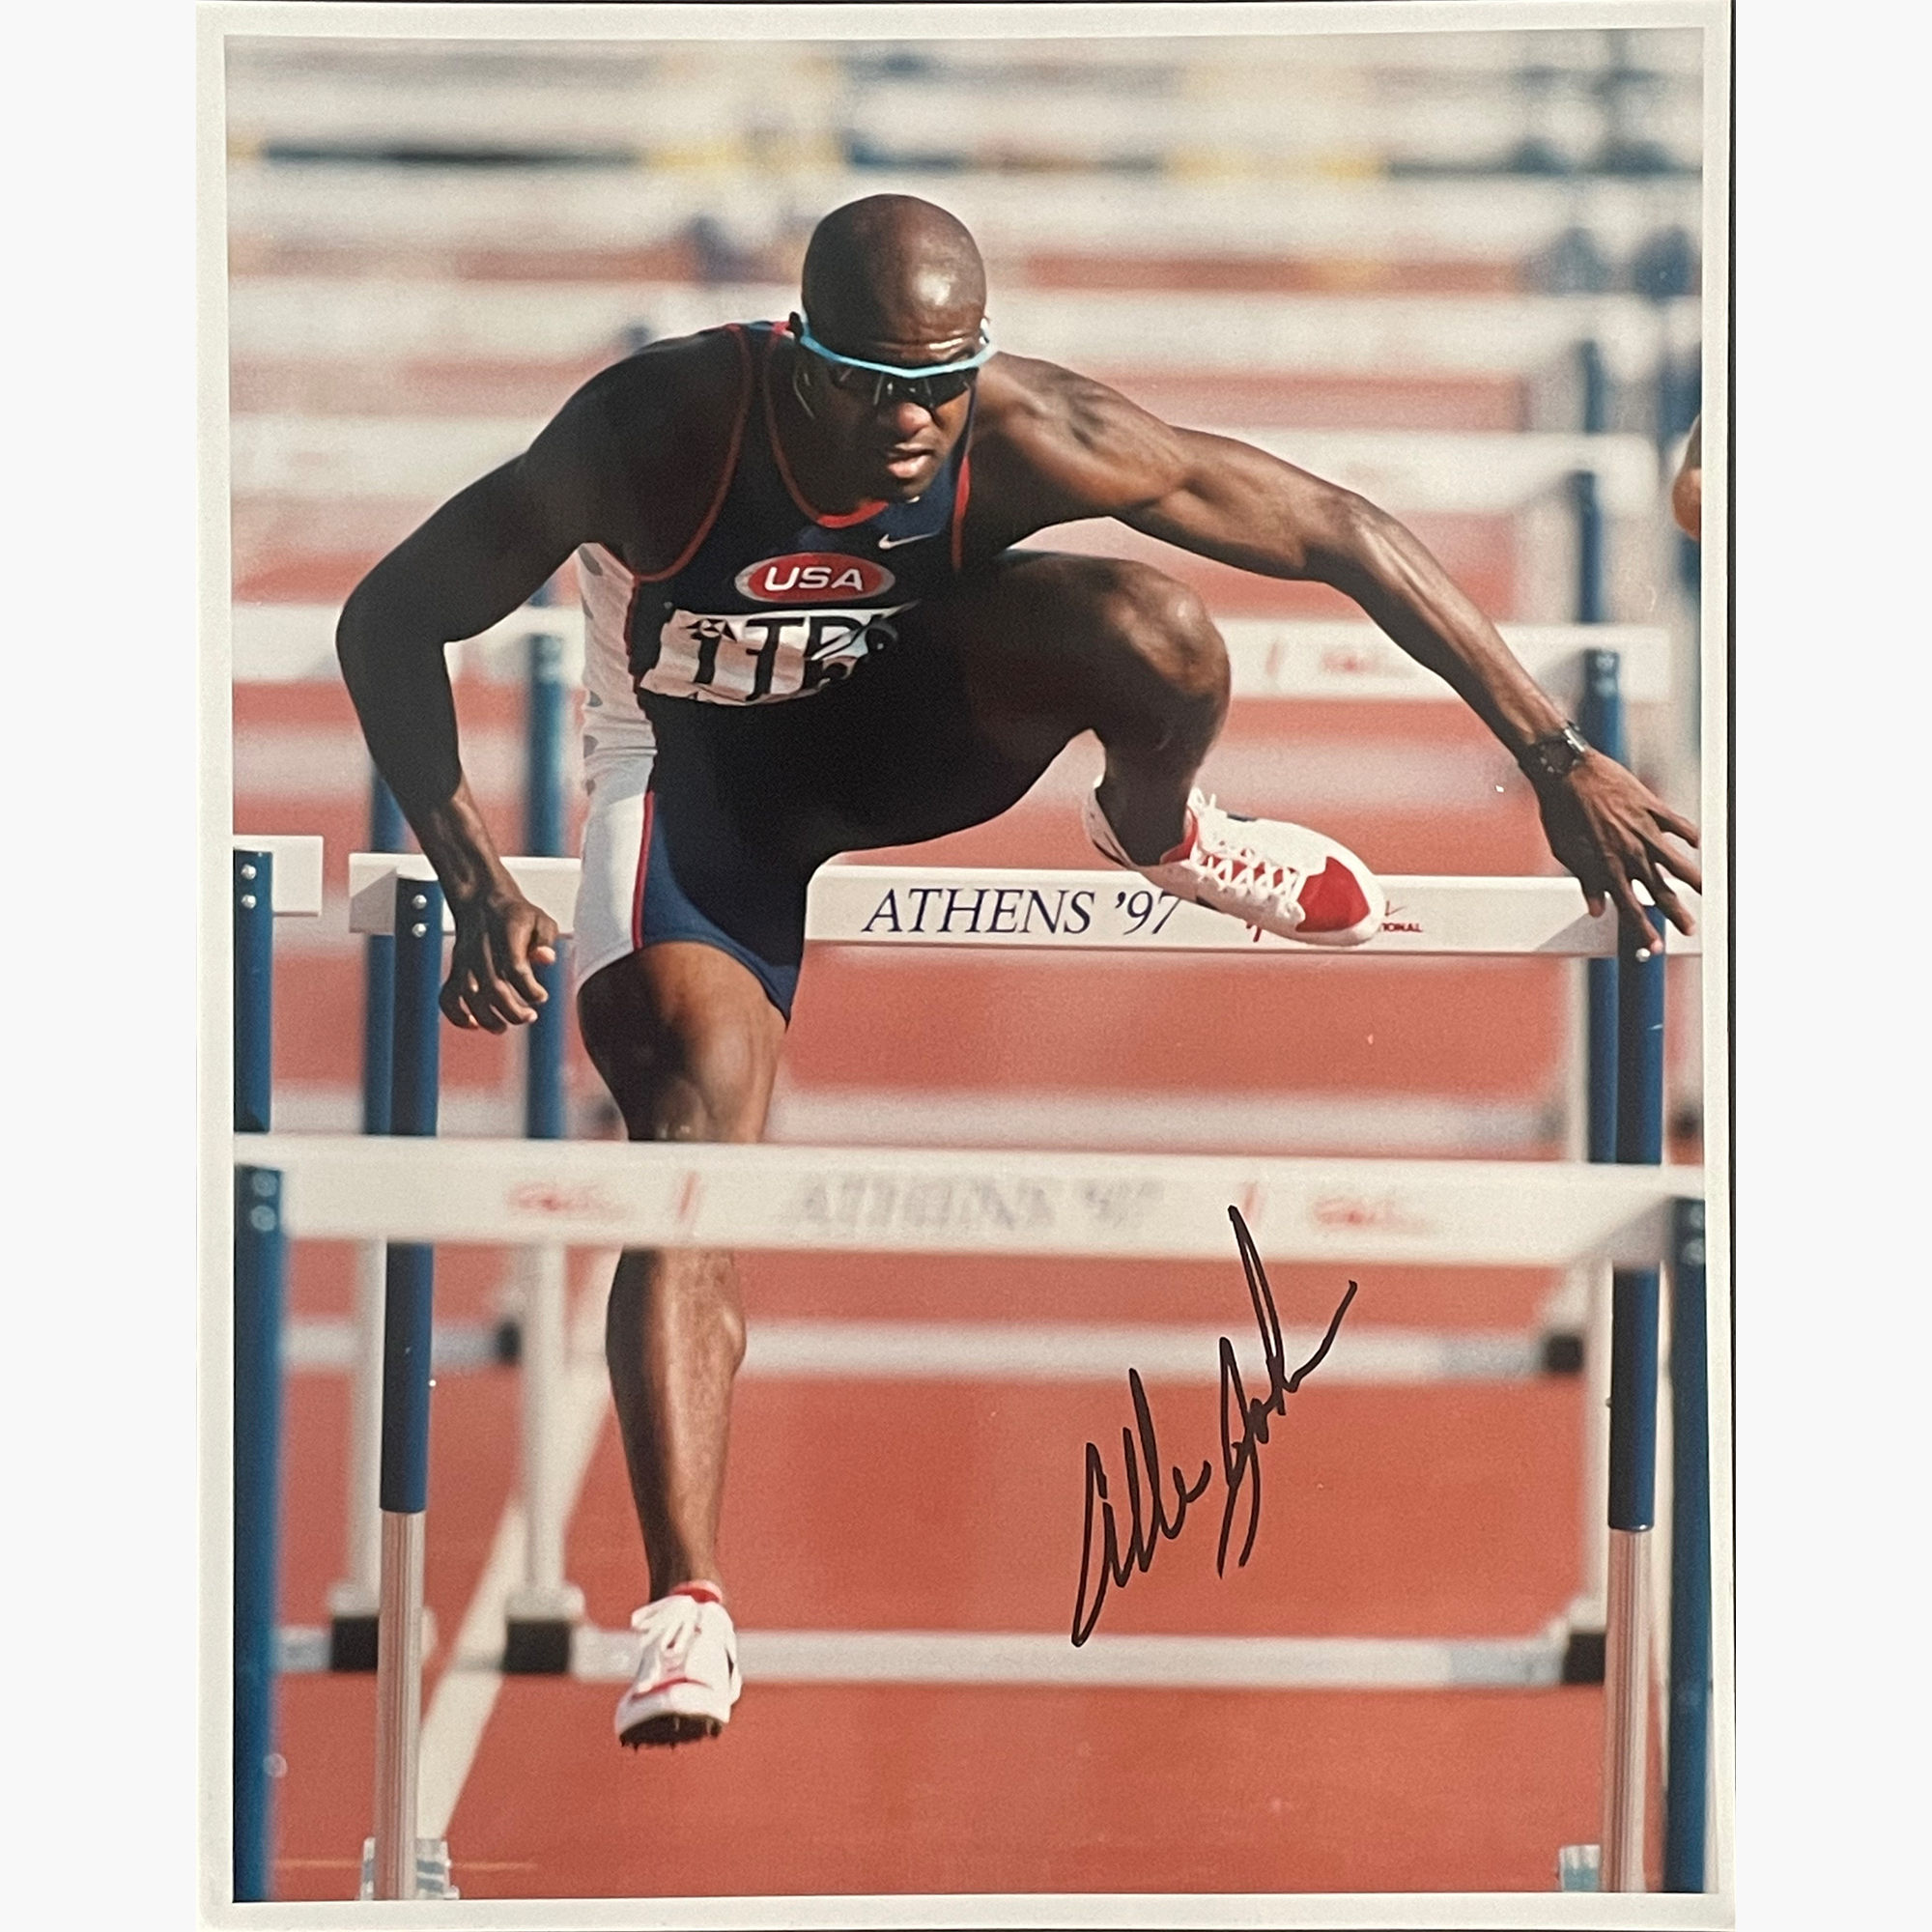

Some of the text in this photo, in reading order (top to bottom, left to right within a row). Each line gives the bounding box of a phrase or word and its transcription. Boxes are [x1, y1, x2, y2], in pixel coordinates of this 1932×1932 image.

[764, 566, 864, 591] USA
[861, 887, 1182, 936] ATHENS '97
